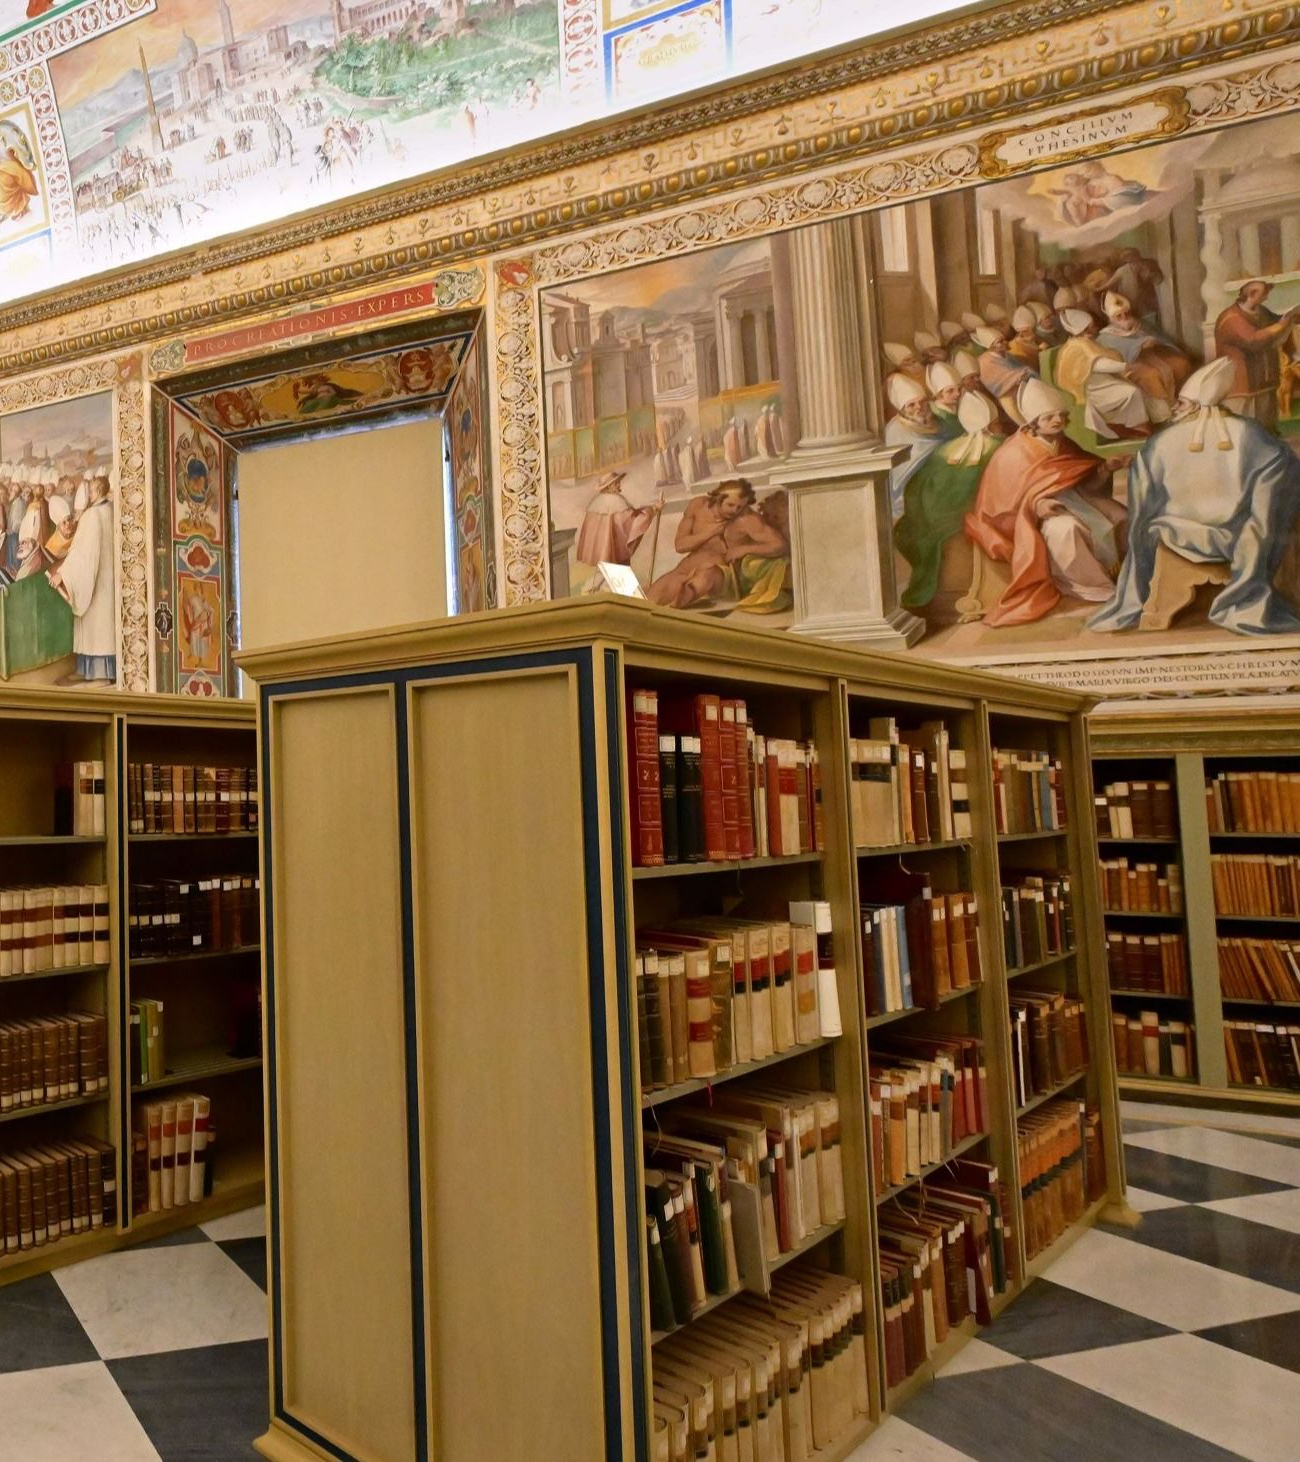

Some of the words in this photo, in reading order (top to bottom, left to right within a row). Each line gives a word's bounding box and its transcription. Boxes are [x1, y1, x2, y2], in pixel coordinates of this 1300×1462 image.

[1019, 111, 1133, 146] CONCILIVM
[1076, 678, 1112, 687] MARIA
[1113, 677, 1150, 685] VIRGO
